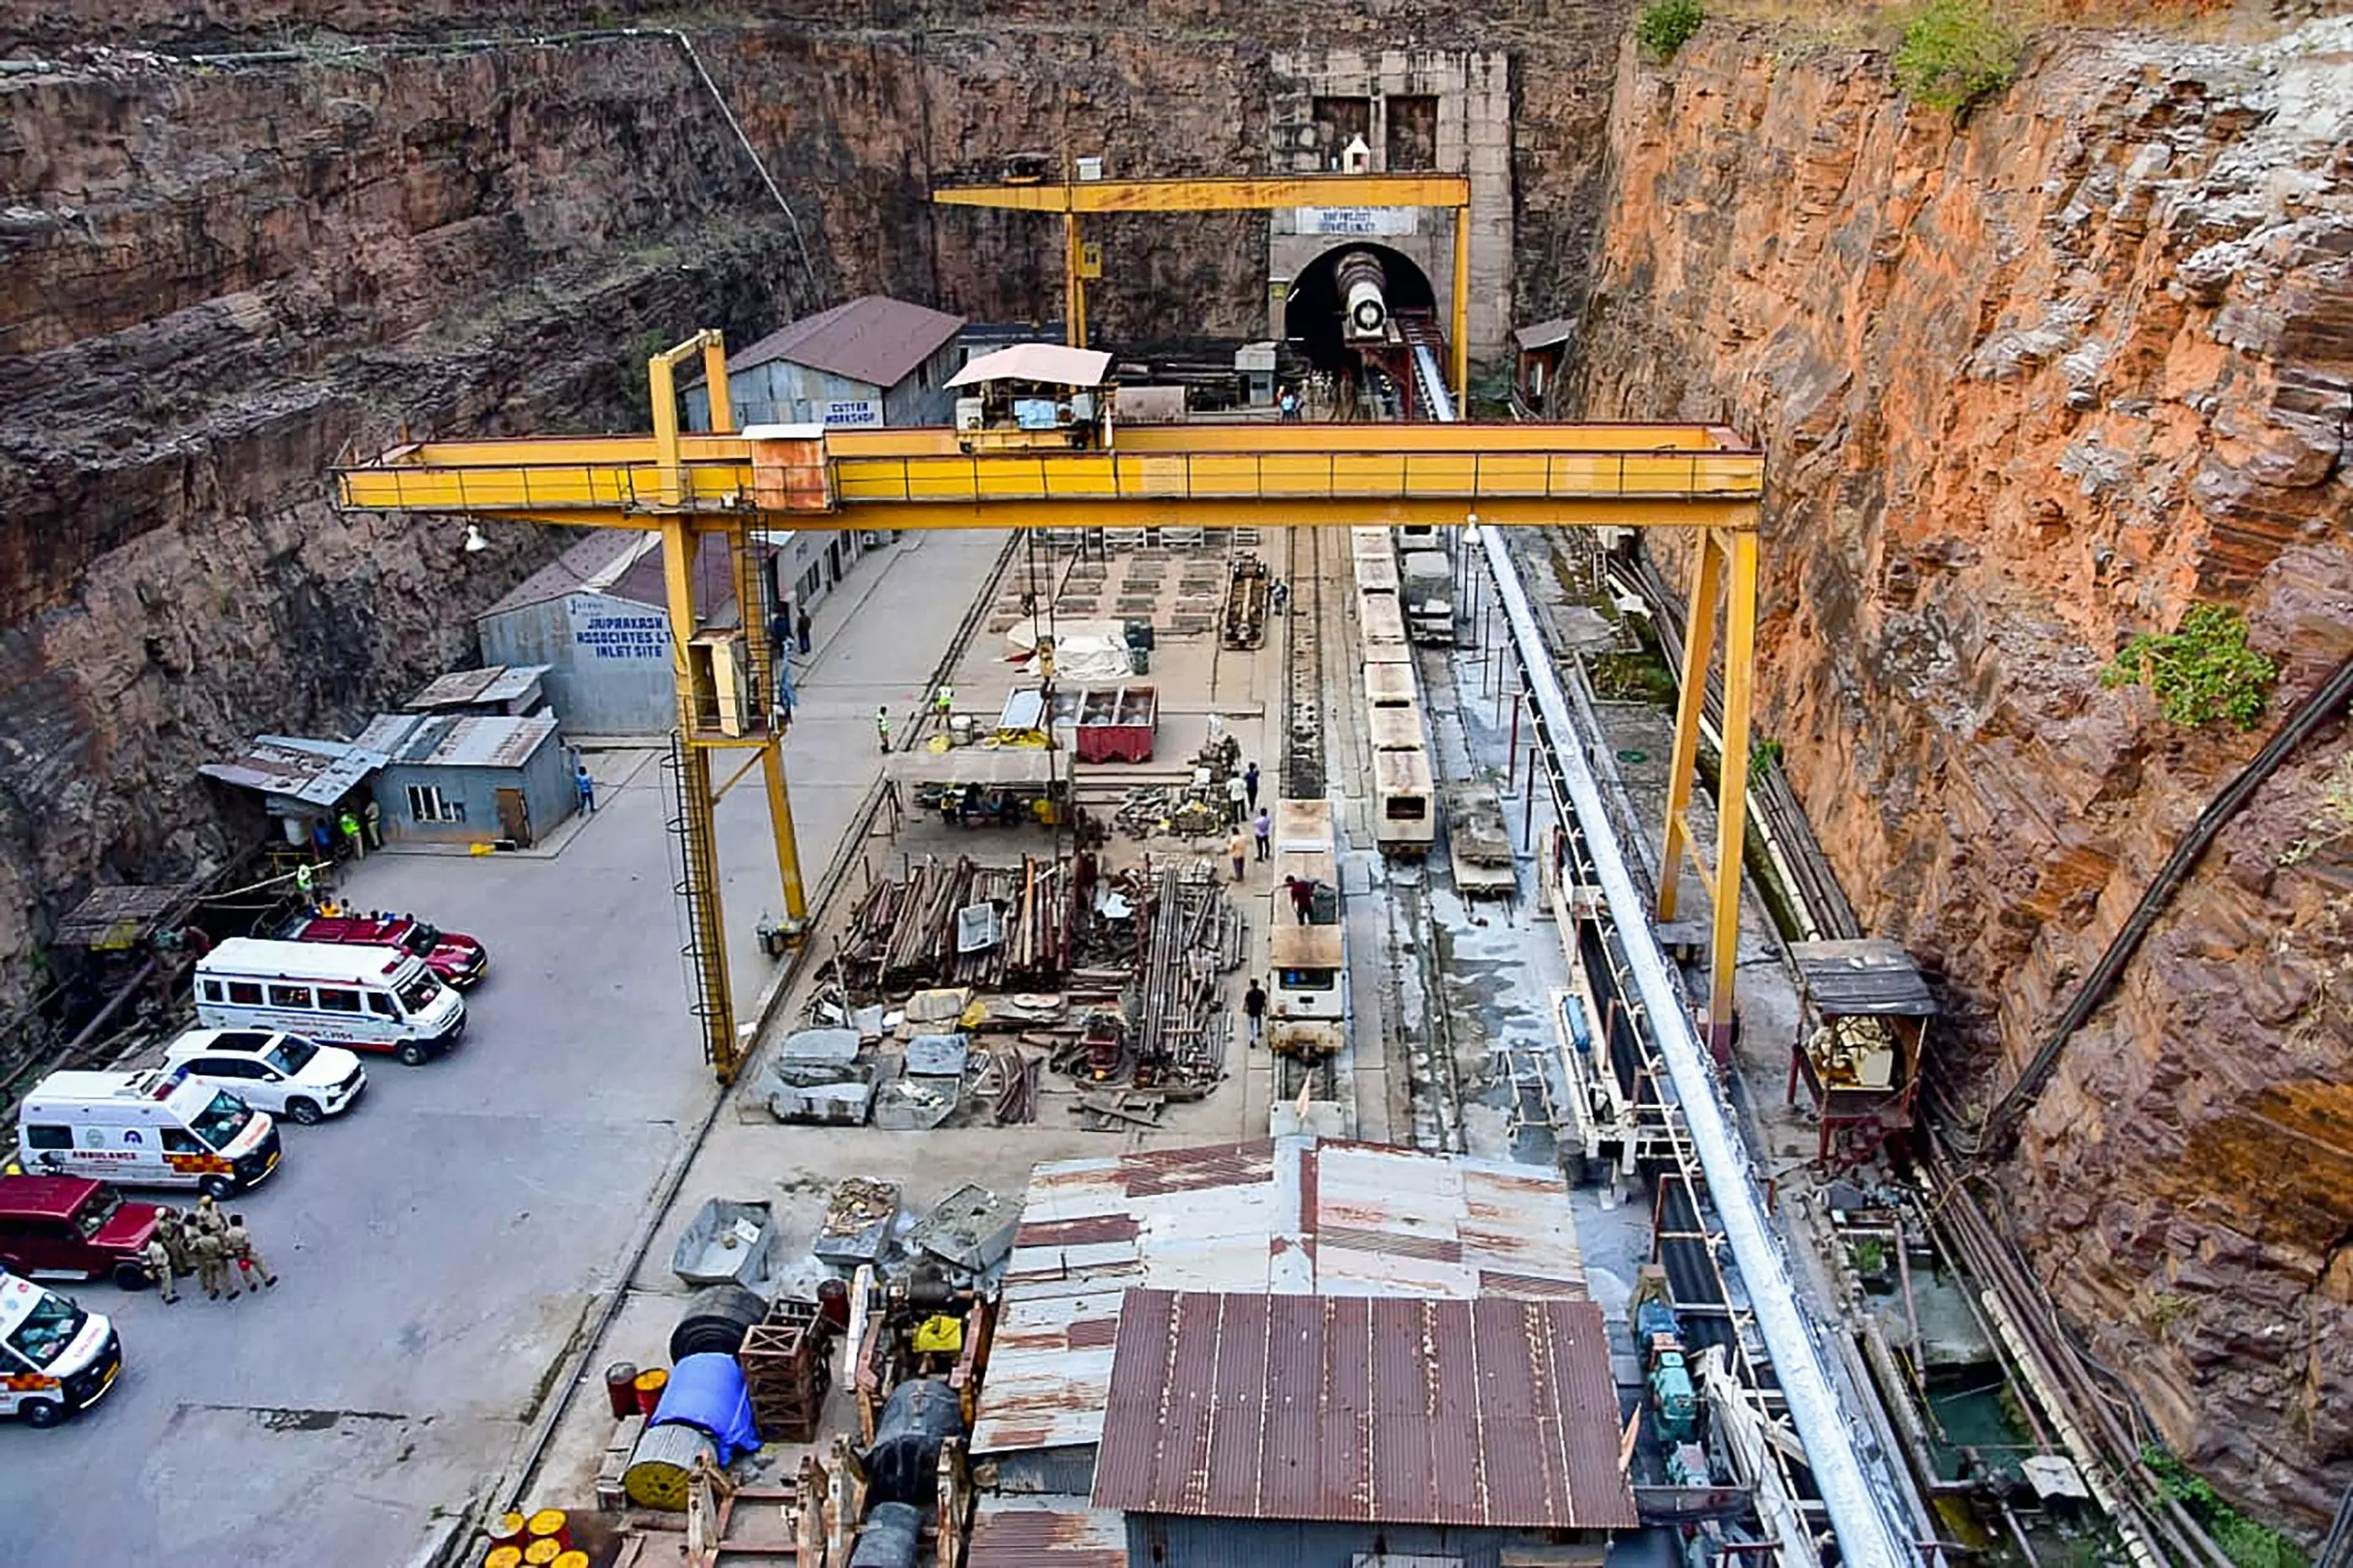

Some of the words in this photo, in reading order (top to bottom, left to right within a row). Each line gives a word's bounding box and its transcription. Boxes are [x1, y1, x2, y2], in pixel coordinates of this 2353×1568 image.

[825, 413, 875, 423] WORKSHOP
[588, 617, 662, 629] JAIPRAKASH
[576, 632, 653, 644] ASSOCIATES
[596, 645, 631, 657] INLET
[634, 645, 662, 657] SITE
[72, 1150, 137, 1160] AMBULANCE
